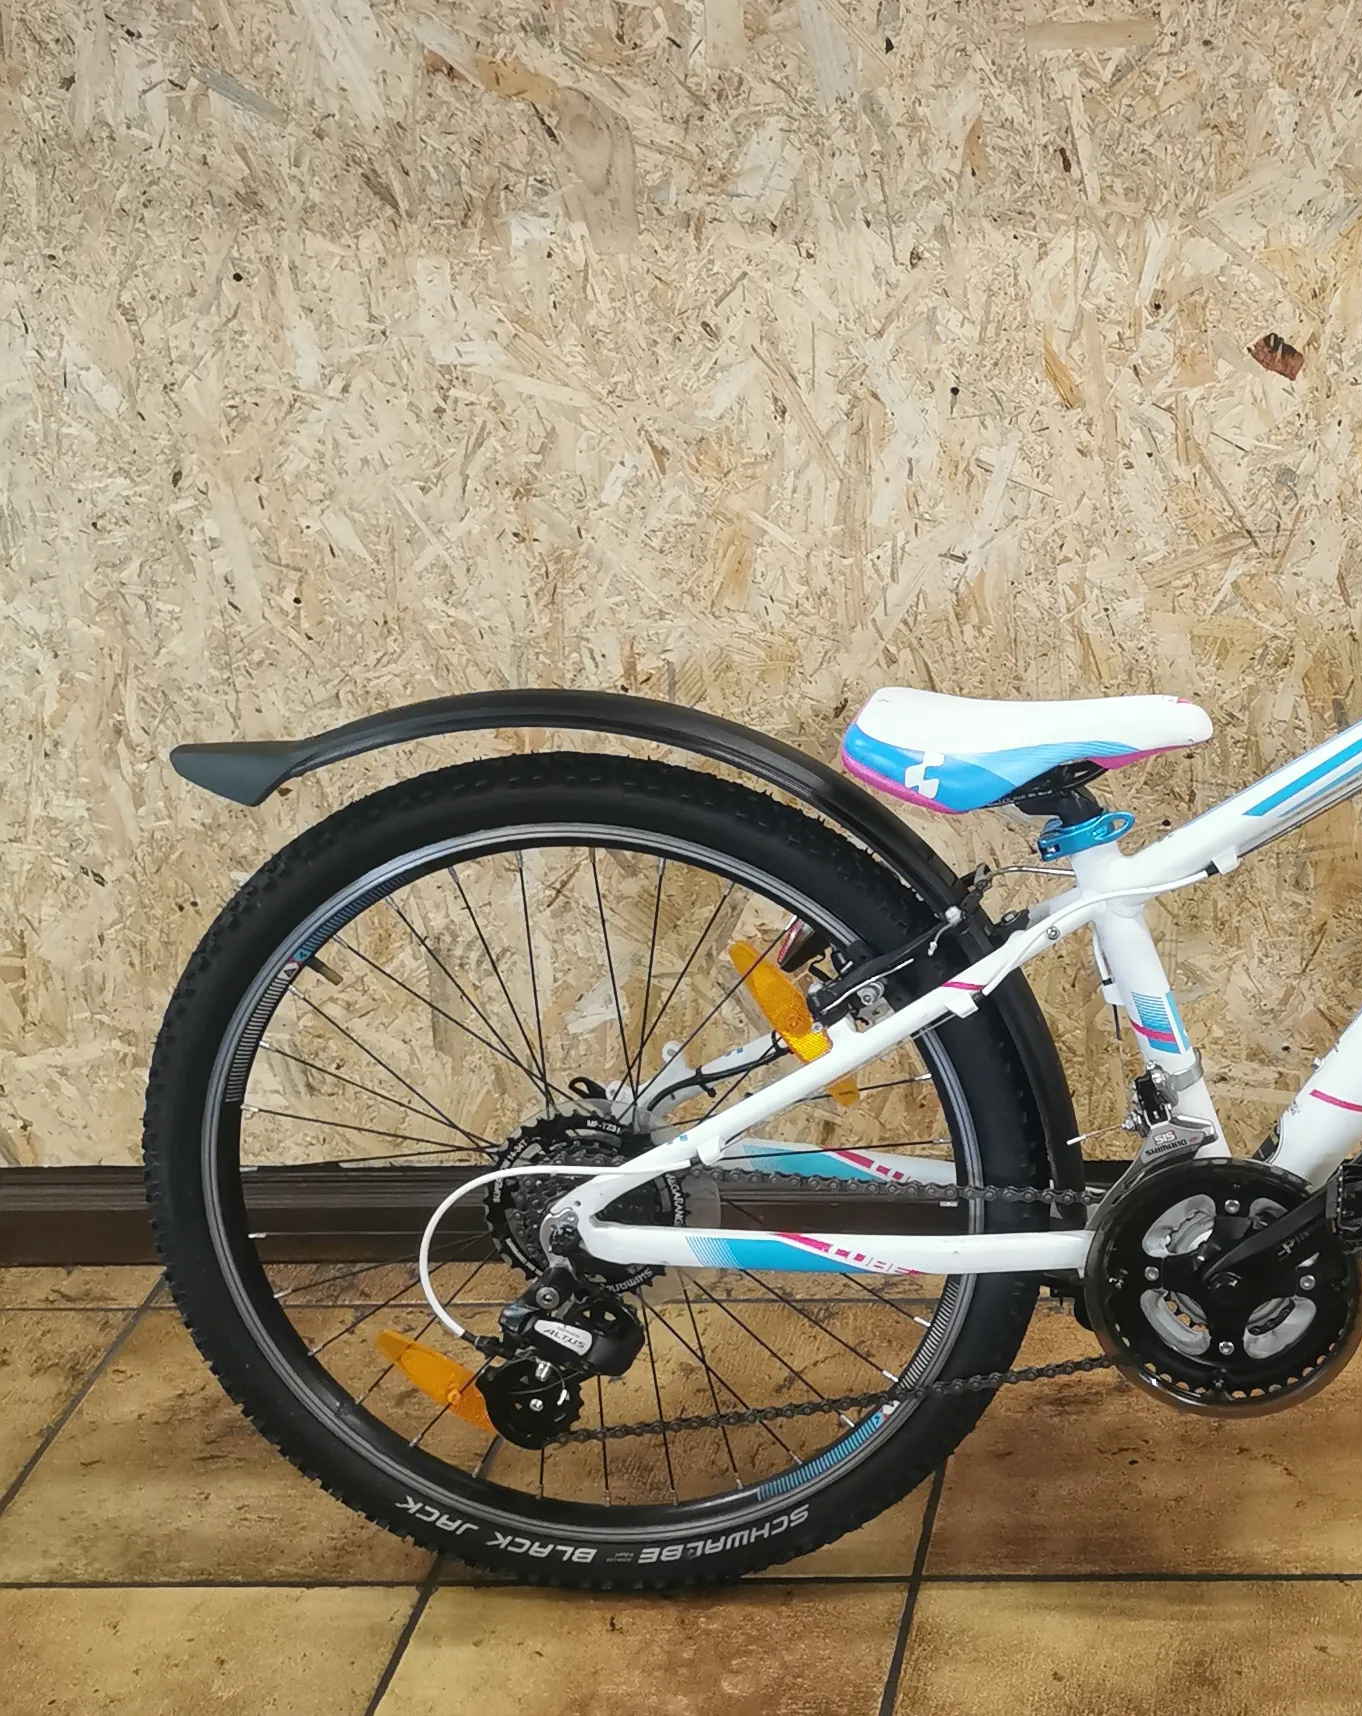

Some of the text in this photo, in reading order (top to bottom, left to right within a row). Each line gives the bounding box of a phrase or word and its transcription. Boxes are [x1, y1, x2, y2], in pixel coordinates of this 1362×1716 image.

[1154, 1131, 1176, 1145] SIS
[543, 1328, 587, 1350] ALTUS
[395, 1494, 810, 1564] SCHWALBE BLACK JACK
